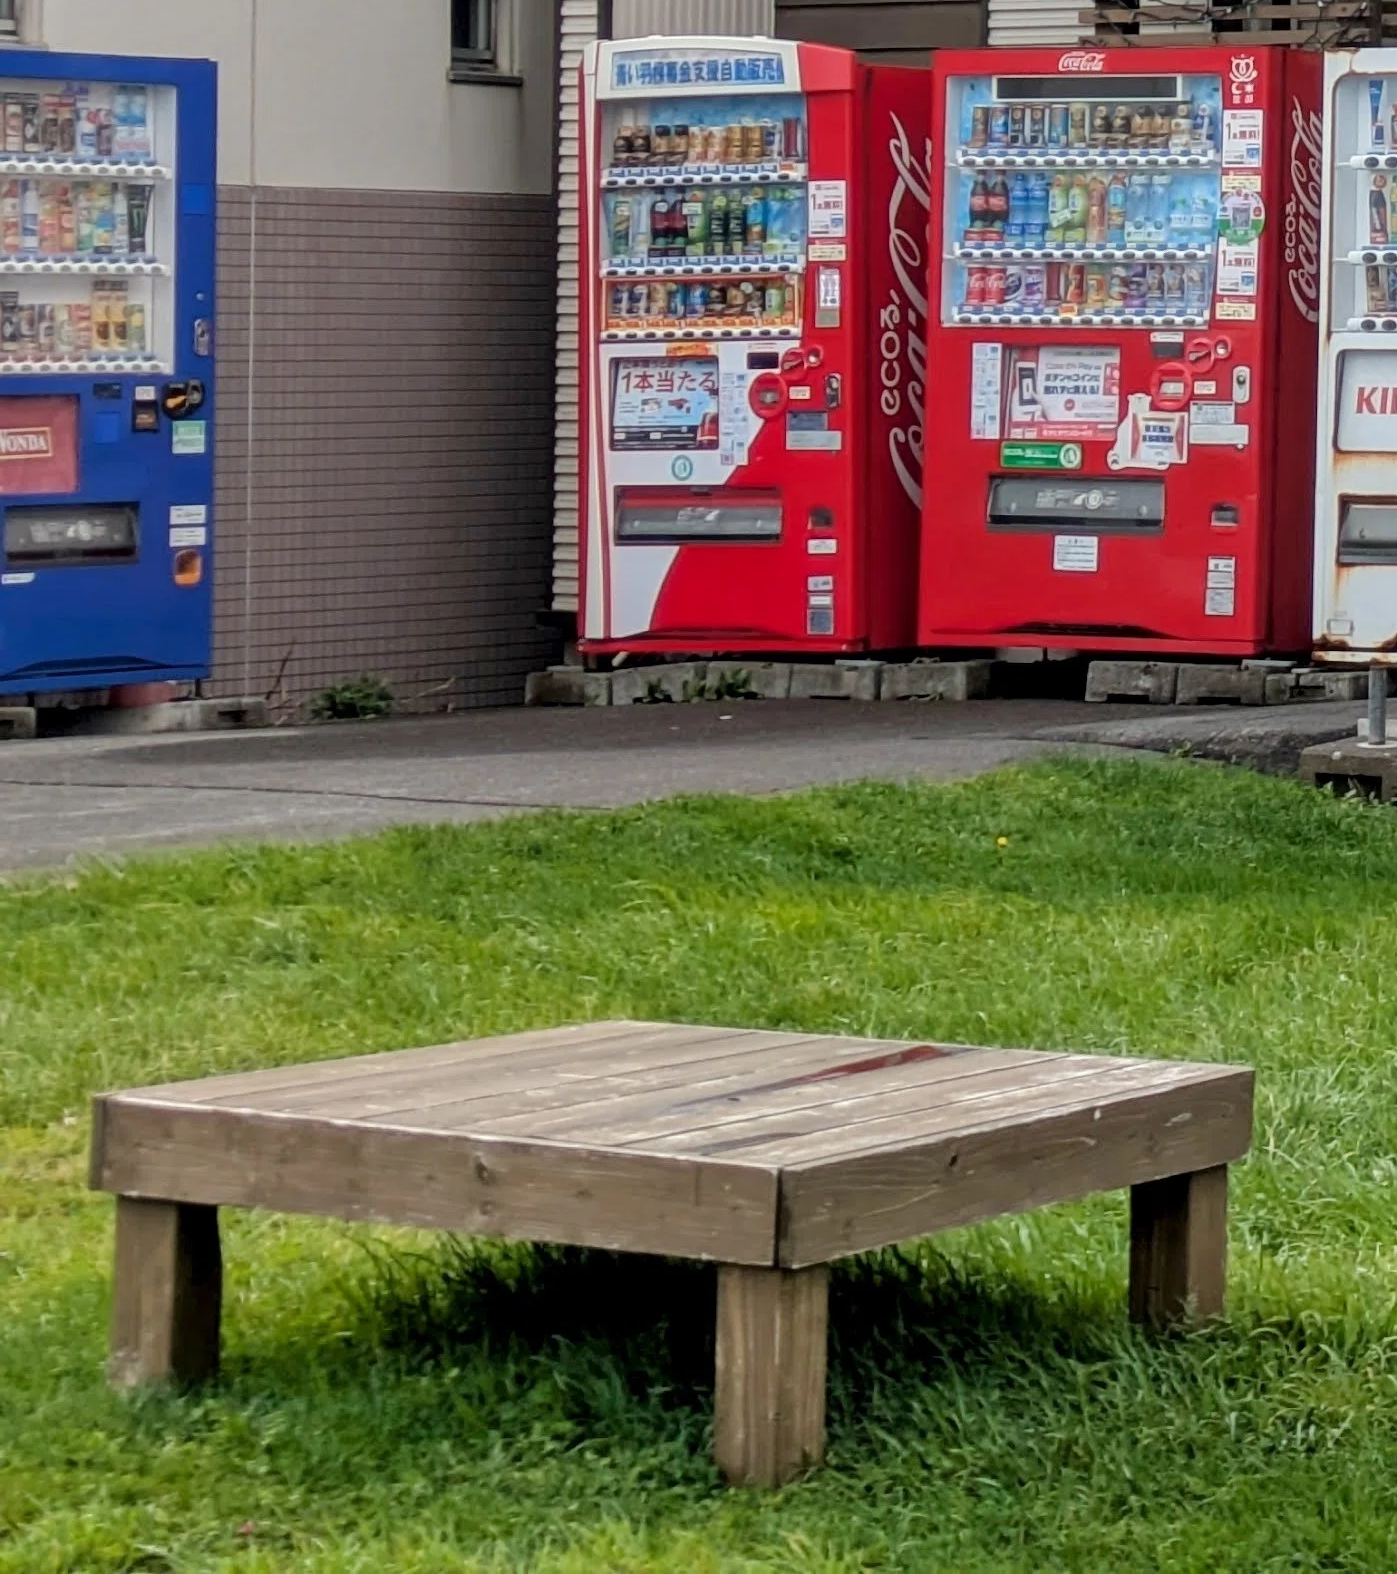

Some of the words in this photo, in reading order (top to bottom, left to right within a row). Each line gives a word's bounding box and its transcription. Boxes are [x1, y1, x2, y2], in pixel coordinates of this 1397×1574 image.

[1059, 50, 1106, 72] Coca-Cola
[621, 369, 716, 394] 1本当たる
